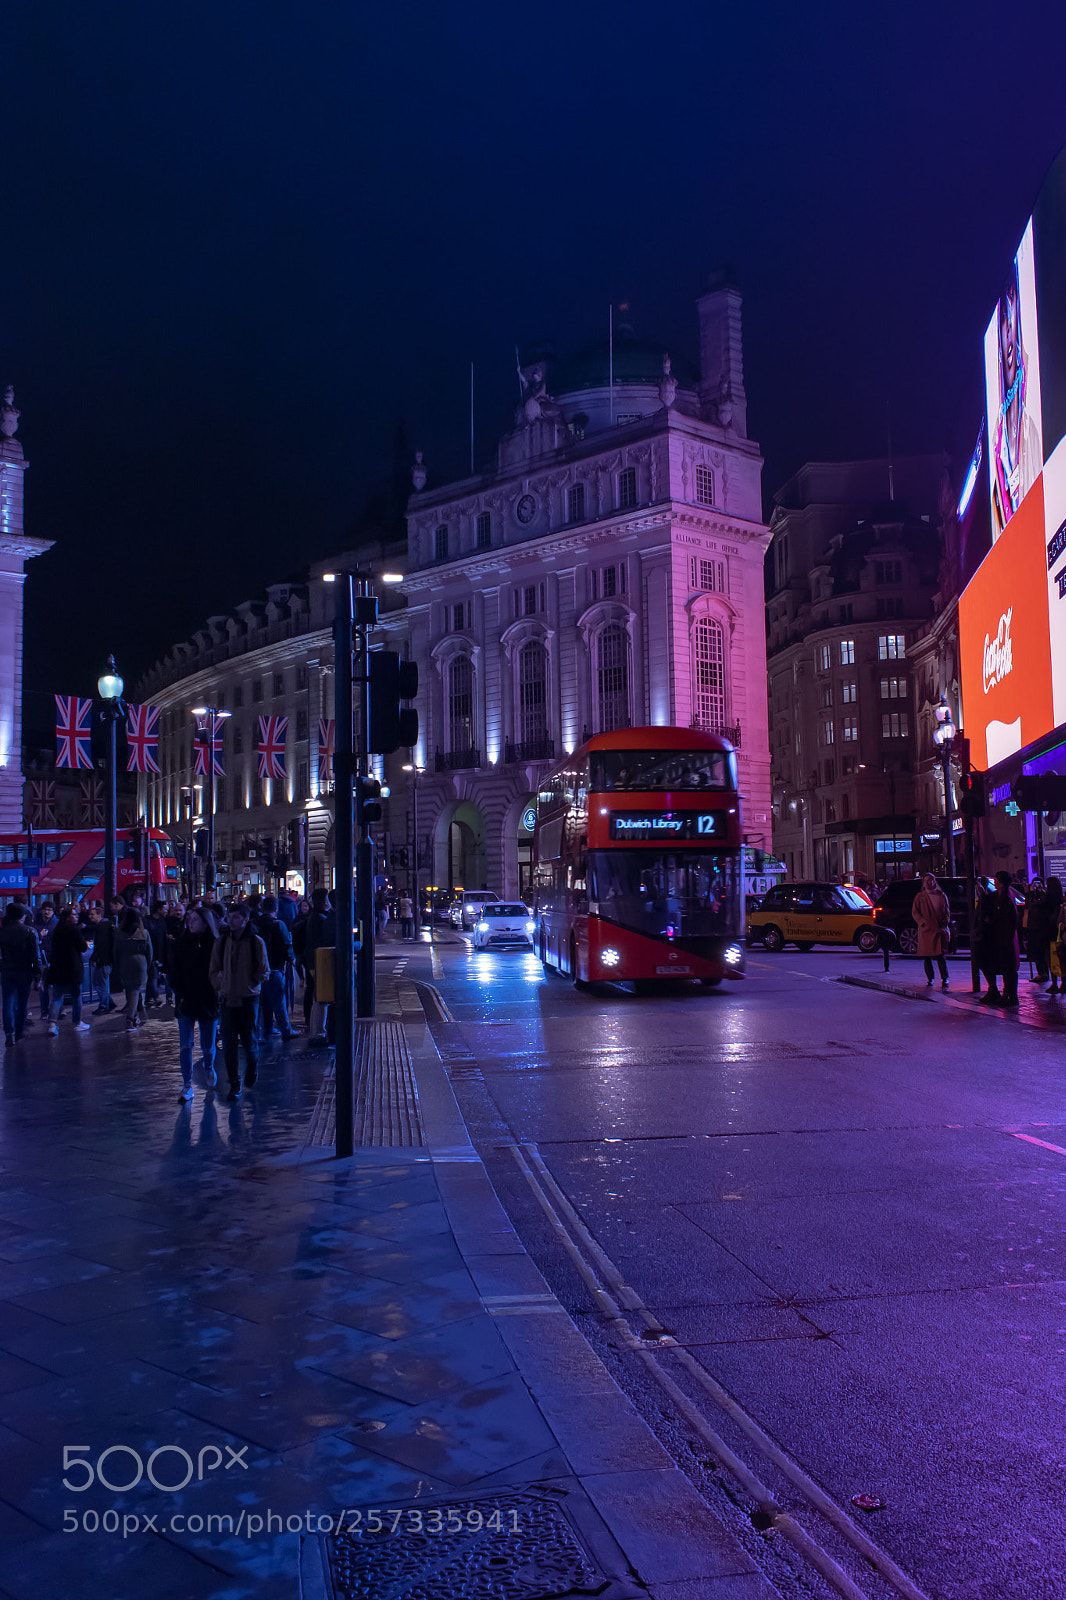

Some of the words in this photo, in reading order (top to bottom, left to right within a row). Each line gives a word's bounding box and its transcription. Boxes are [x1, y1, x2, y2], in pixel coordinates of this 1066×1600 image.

[676, 534, 702, 546] ALLIANCE
[706, 540, 717, 550] LIFE
[722, 544, 739, 555] OFFICE
[616, 819, 652, 829] Dulwich
[652, 819, 683, 831] Library
[697, 815, 715, 834] 12
